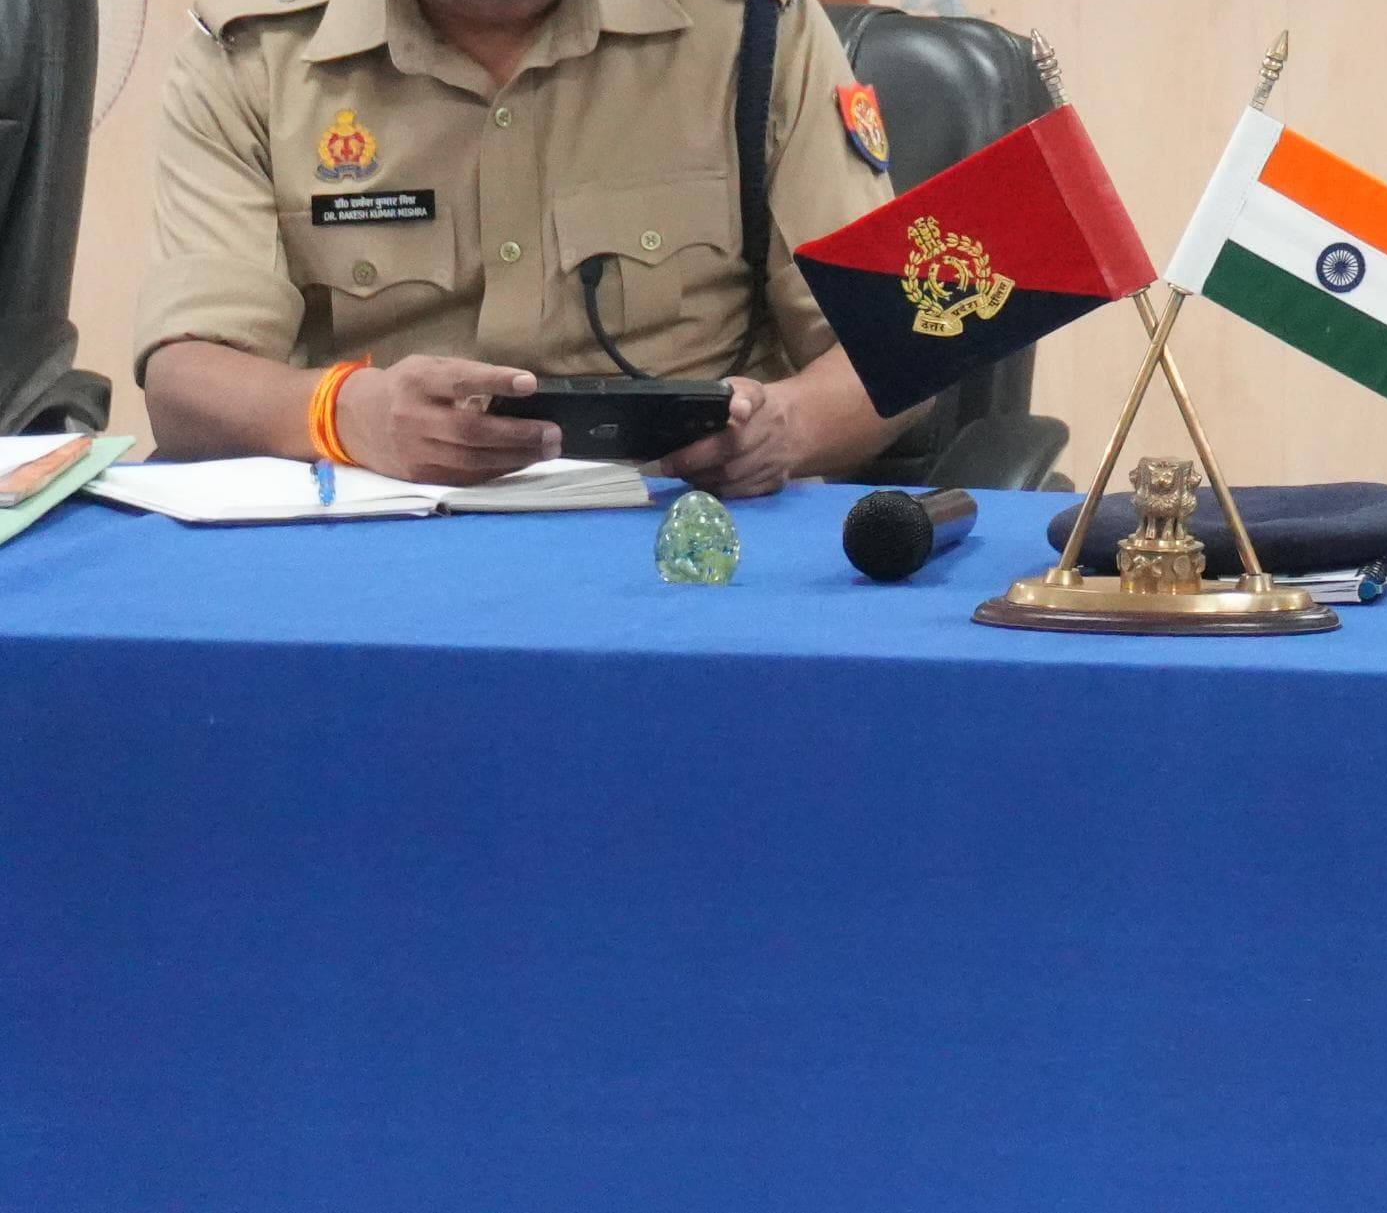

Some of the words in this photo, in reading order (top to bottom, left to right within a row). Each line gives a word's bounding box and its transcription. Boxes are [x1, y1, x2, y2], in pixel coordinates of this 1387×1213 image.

[339, 210, 368, 220] RAKESH
[370, 209, 397, 219] KUMAR
[398, 207, 427, 217] MISHRA
